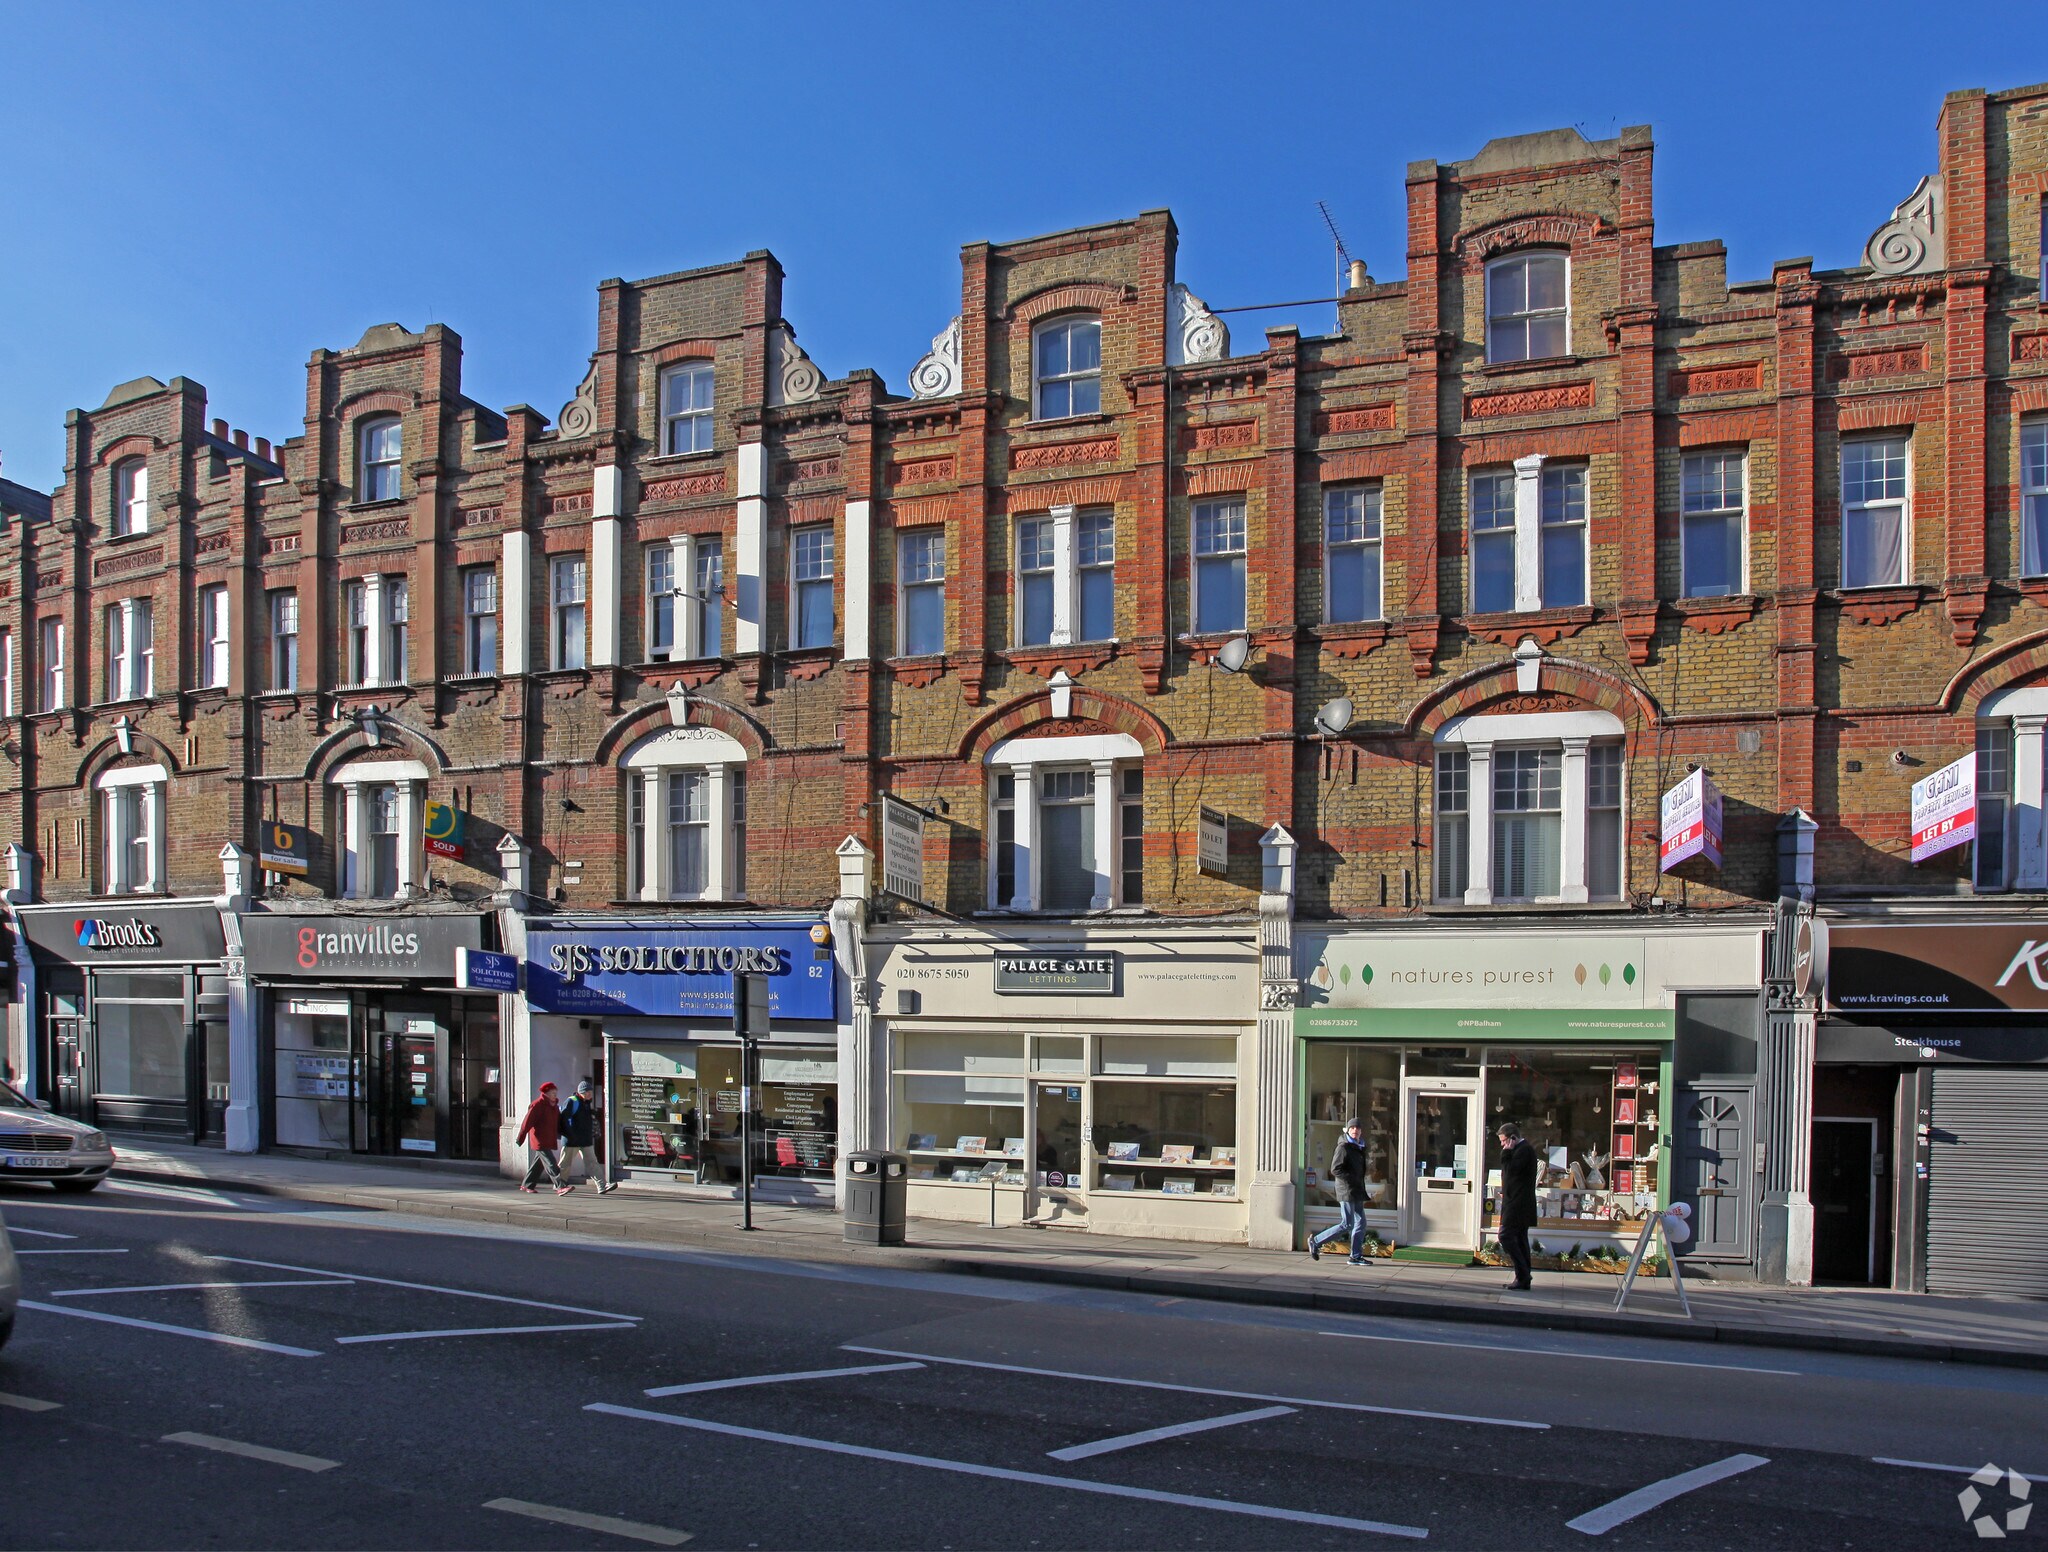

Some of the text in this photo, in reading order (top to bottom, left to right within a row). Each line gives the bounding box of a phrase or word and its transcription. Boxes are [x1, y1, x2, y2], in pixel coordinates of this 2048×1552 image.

[1925, 763, 1959, 799] GANI
[1671, 777, 1694, 811] GANI
[889, 806, 906, 820] PALACE
[891, 828, 915, 845] Letting &
[1703, 827, 1711, 842] LET
[1922, 817, 1955, 843] LET BY
[1201, 831, 1223, 845] TO LET
[1668, 828, 1691, 852] LET BY
[433, 840, 456, 852] SOLD
[888, 838, 920, 856] management
[891, 849, 916, 864] specialists
[95, 917, 155, 946] Brooks
[297, 925, 419, 969] granvilles
[372, 960, 418, 968] AGENTS
[485, 955, 500, 969] SJS
[549, 943, 781, 982] SJS SOLICITORS
[999, 959, 1106, 972] PALACE GATE
[471, 967, 515, 979] SOLICITORS
[808, 966, 823, 978] 82
[897, 968, 970, 980] 020 8675 5050
[1137, 973, 1237, 982] www.palacegatelettings.com
[1391, 967, 1555, 987] natures purest
[1029, 975, 1077, 984] LETTINGS
[572, 989, 590, 998] 0208
[592, 989, 606, 998] 675
[608, 990, 627, 999] 4436
[680, 990, 779, 1000] www.sjssolicuk
[1840, 993, 1950, 1005] www.kravings.co.uk
[401, 1016, 418, 1032] 84
[1457, 1019, 1502, 1028] @NPBalham
[1567, 1021, 1667, 1029] www.naturespurest.co.uk
[1894, 1036, 1961, 1047] Steakhouse
